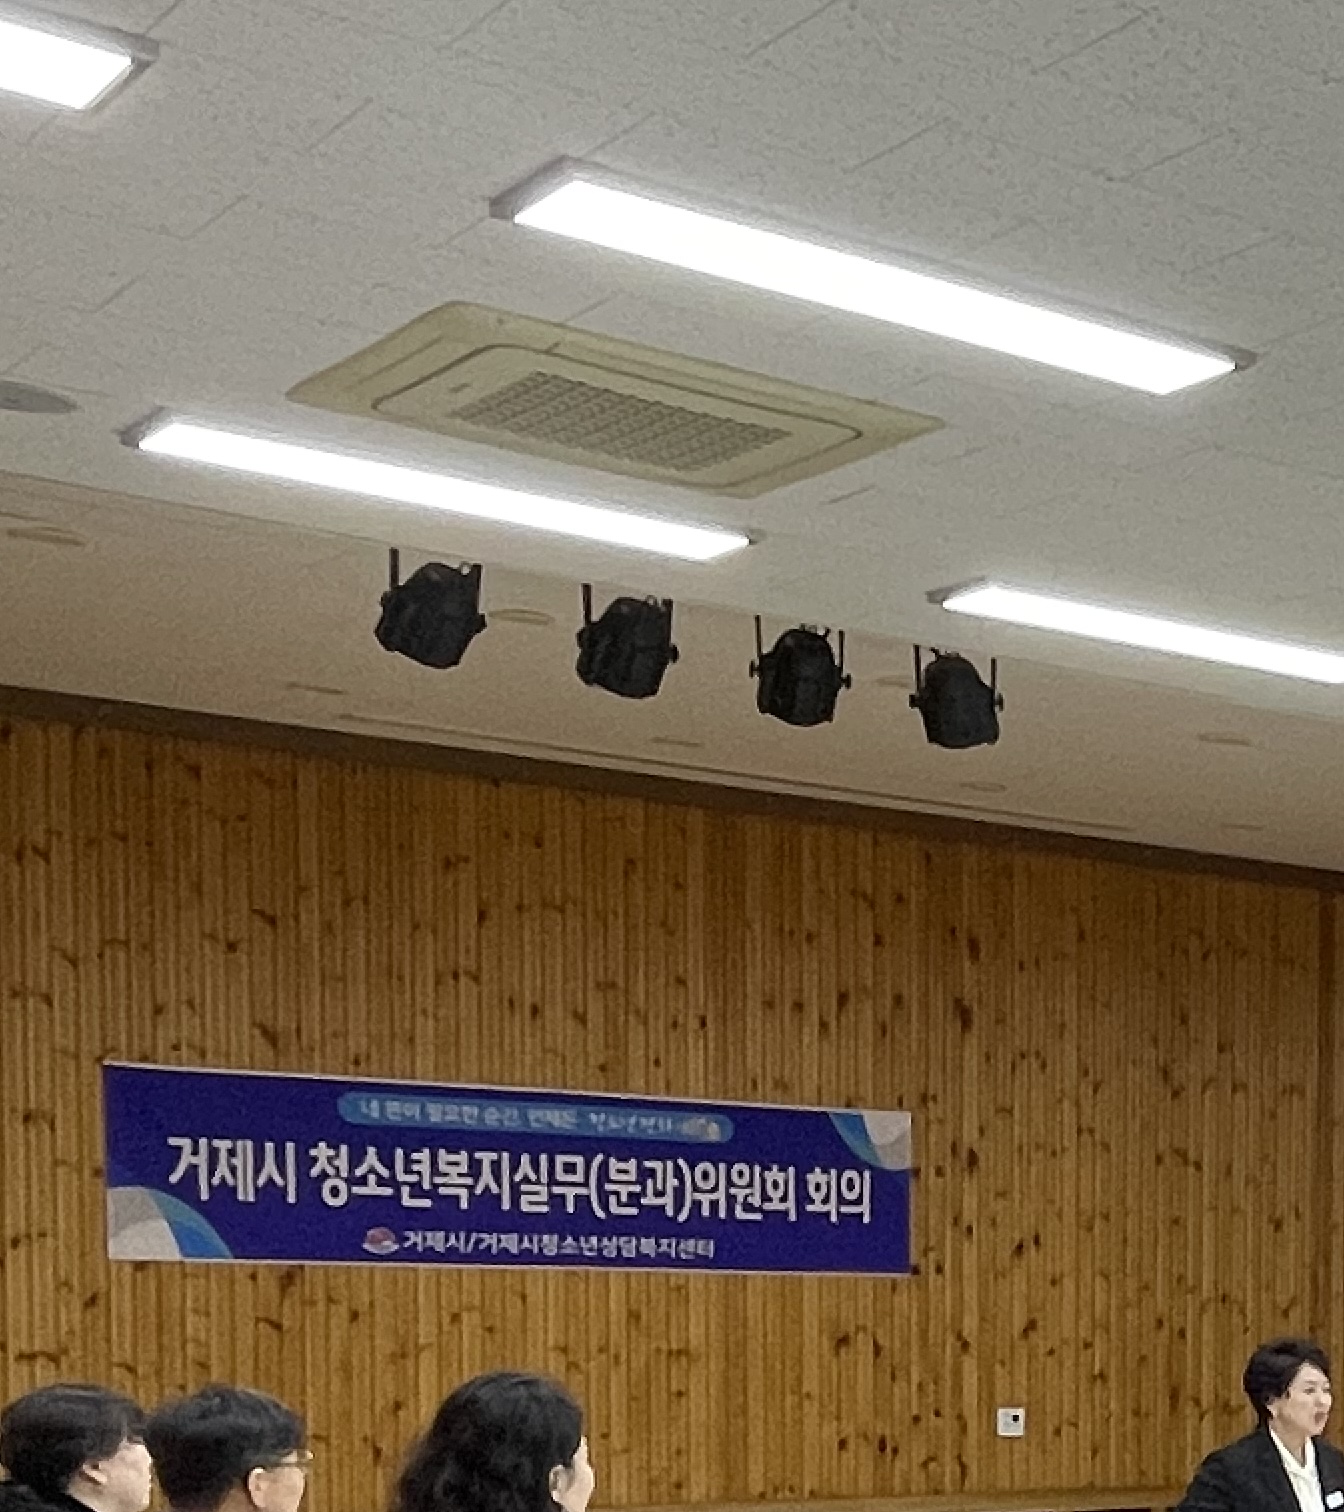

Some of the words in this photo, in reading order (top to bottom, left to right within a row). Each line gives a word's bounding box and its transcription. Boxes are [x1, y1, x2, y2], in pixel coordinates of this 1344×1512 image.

[166, 1136, 298, 1205] 거제시
[308, 1141, 799, 1224] 청소년복지실무(분과)위원회
[805, 1166, 872, 1225] 회의
